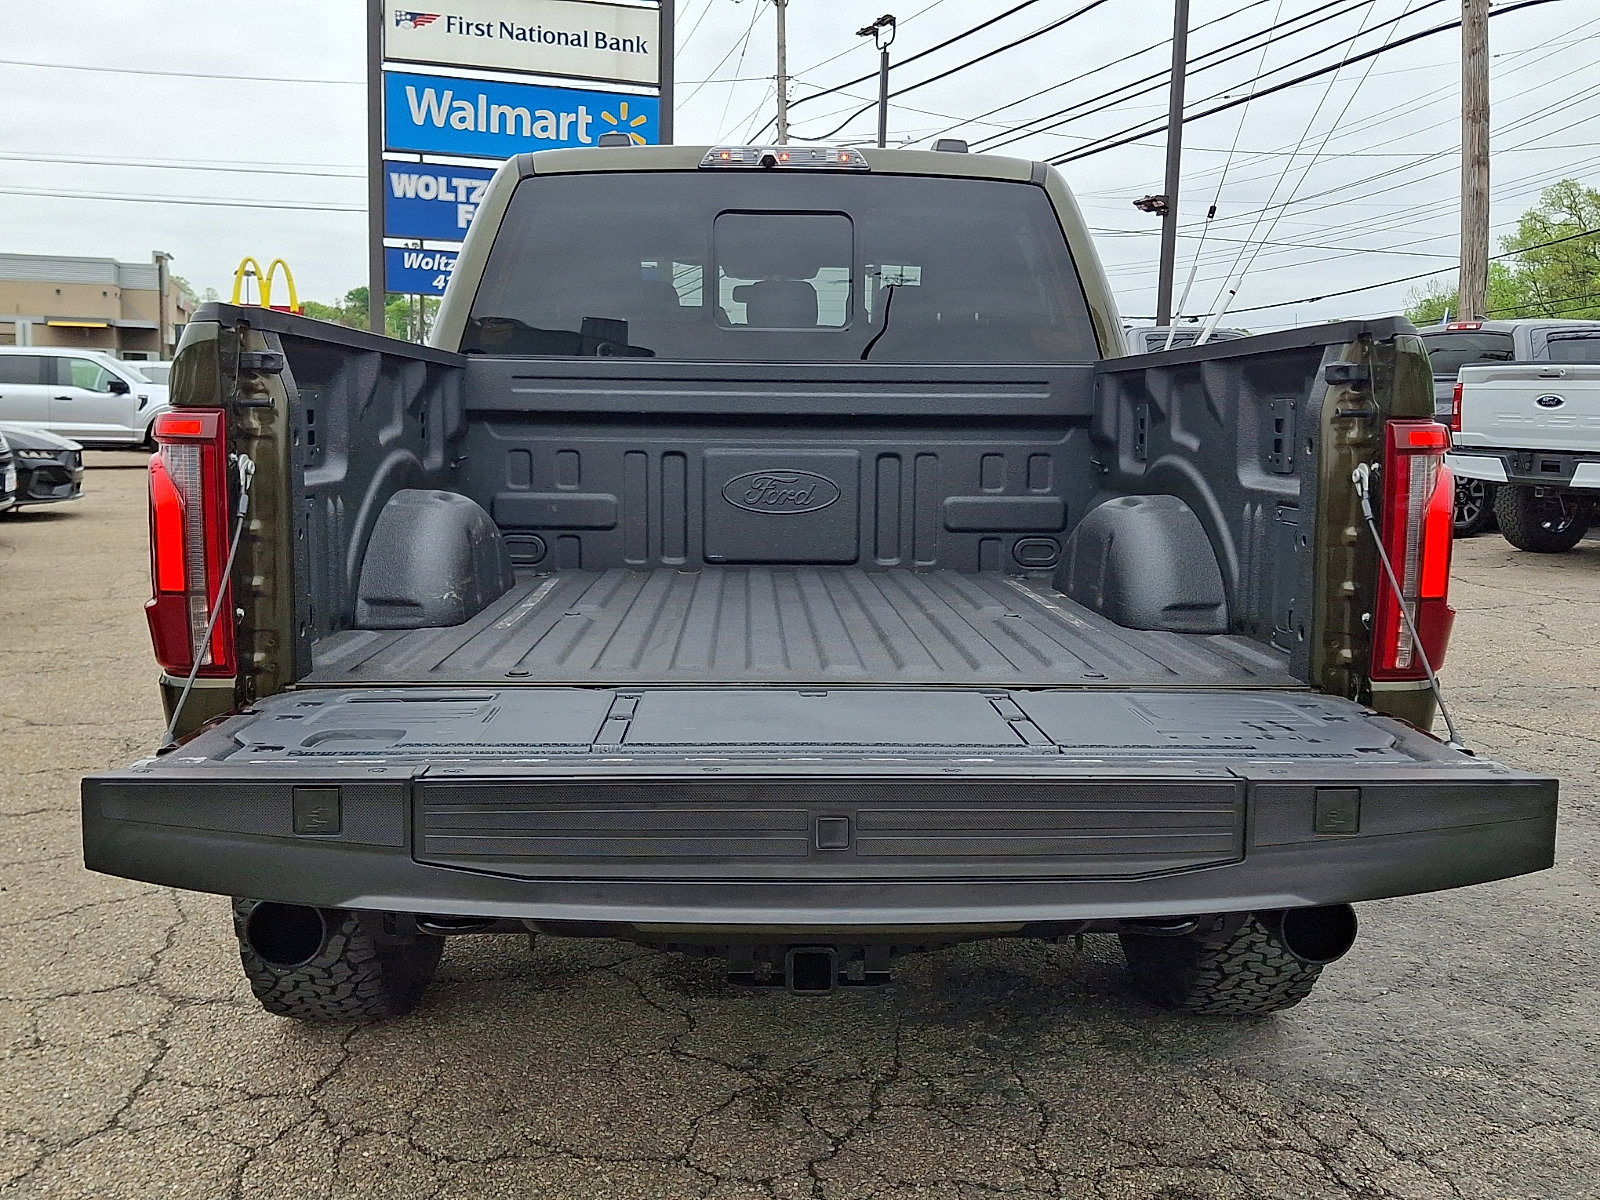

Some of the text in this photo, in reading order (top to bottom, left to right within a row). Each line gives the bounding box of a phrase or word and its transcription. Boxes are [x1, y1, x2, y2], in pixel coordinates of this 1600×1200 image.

[446, 15, 649, 55] First National Bank
[405, 86, 593, 144] Walmart
[744, 475, 817, 506] Ford
